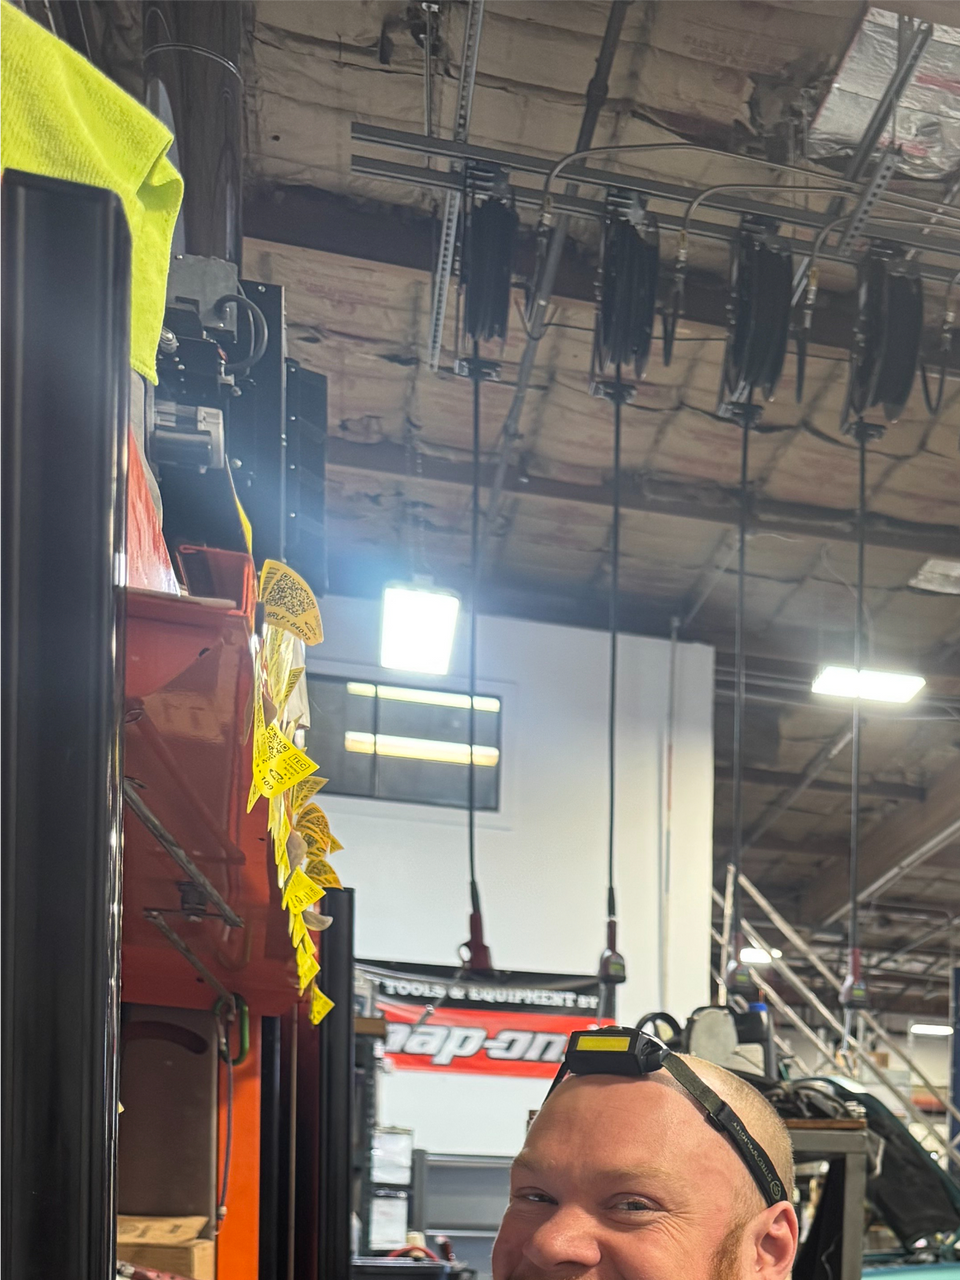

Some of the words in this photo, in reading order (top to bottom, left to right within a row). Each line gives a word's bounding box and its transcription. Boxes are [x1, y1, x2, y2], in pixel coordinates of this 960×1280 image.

[292, 756, 307, 770] TEC
[384, 980, 447, 998] TOOLS
[447, 985, 465, 999] &
[467, 986, 577, 1007] EQUIPMENT
[577, 994, 599, 1008] BY
[385, 1022, 567, 1066] nap-on
